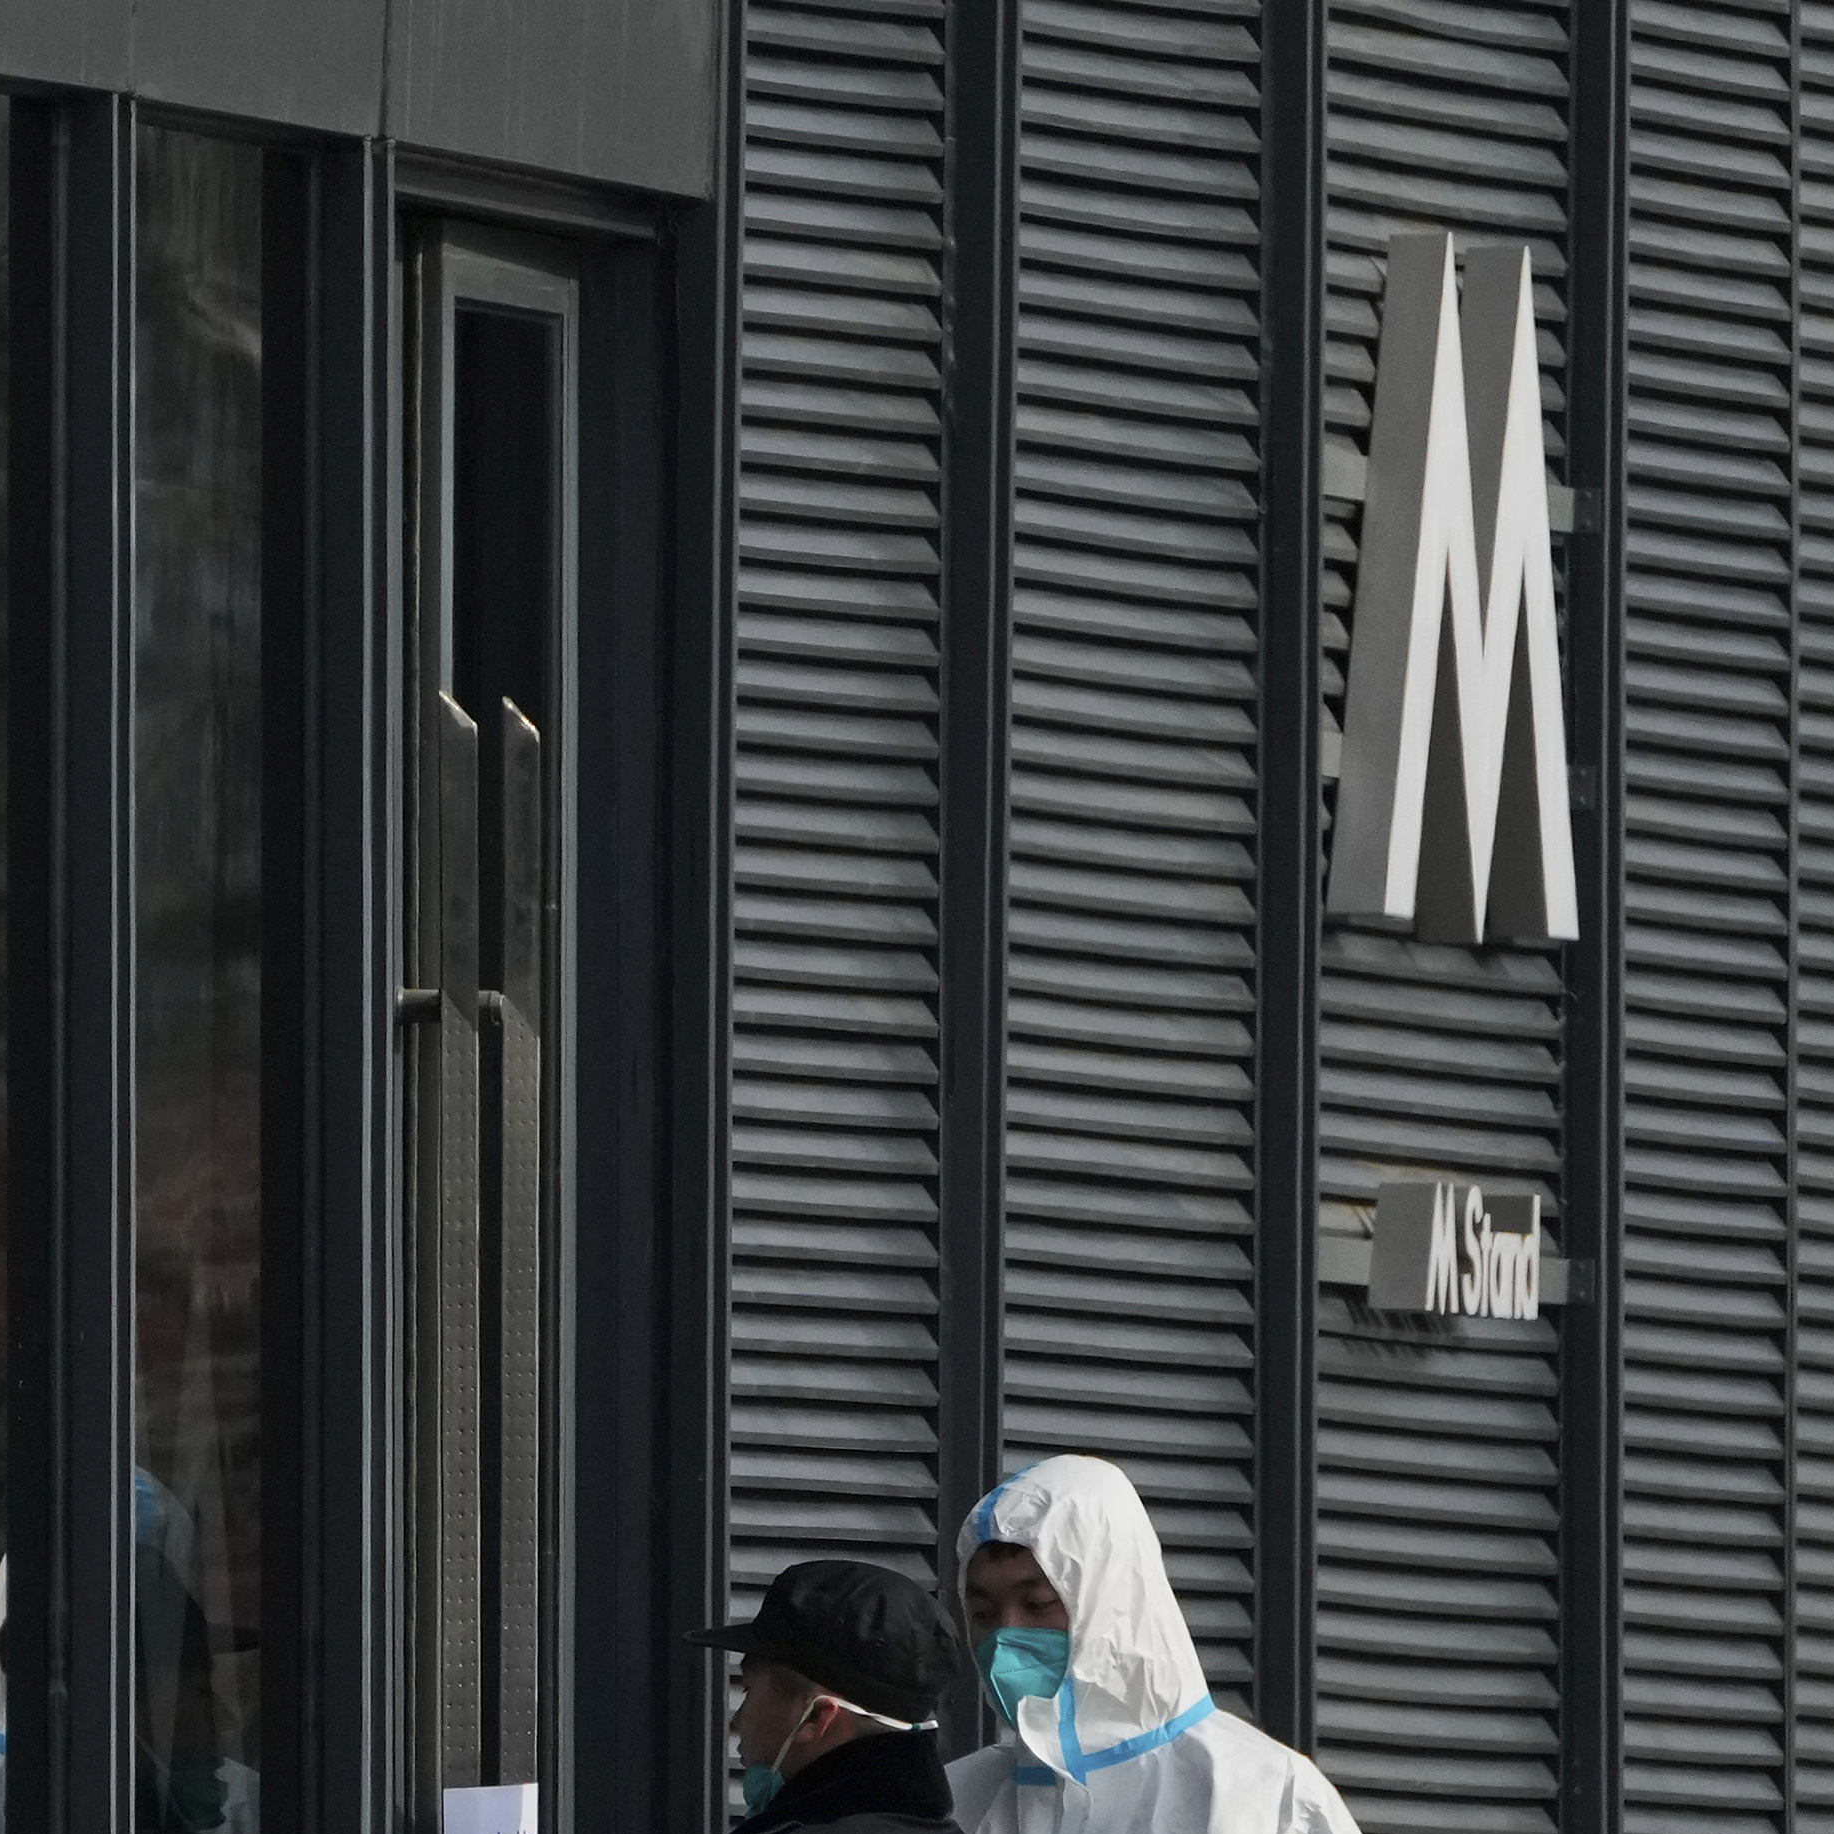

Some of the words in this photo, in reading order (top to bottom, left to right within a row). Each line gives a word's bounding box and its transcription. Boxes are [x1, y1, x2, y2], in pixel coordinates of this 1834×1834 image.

[1384, 232, 1578, 944] M
[1424, 1180, 1459, 1315] M
[1462, 1185, 1541, 1320] Stand
